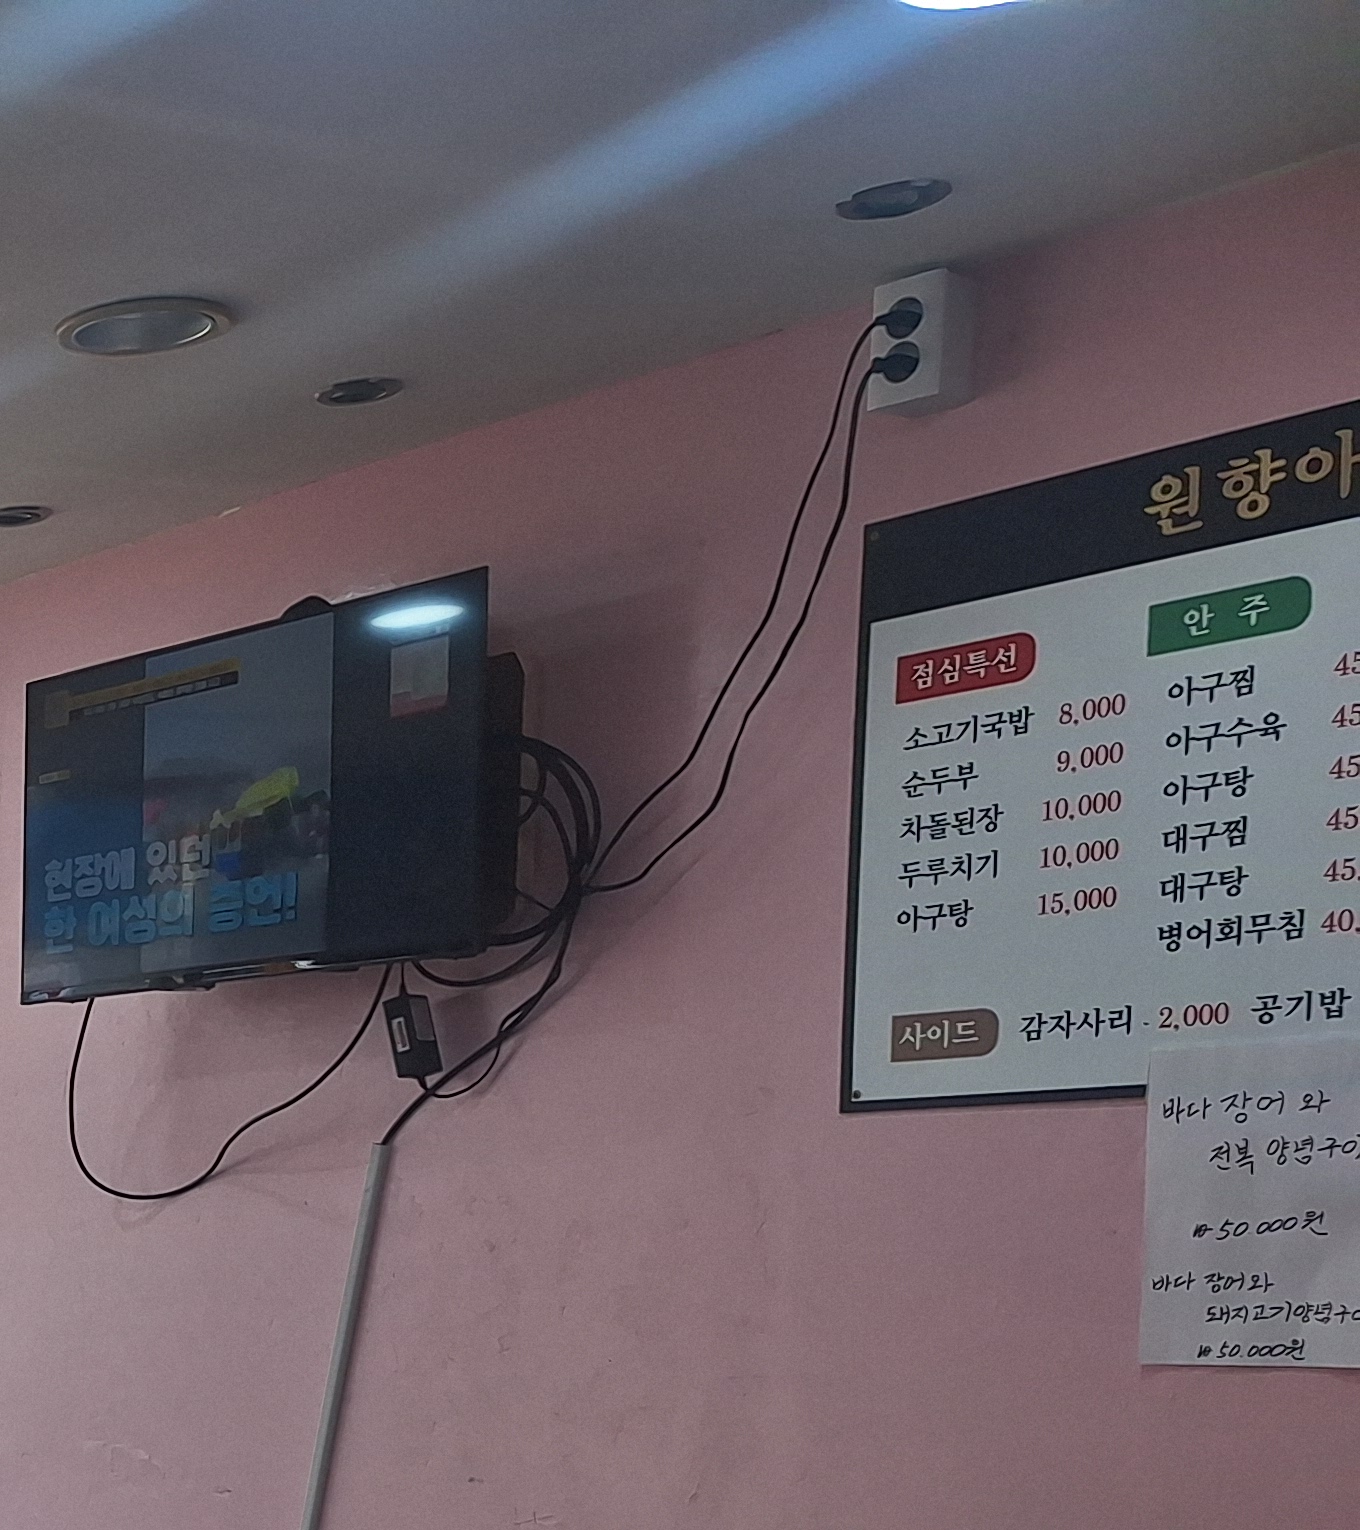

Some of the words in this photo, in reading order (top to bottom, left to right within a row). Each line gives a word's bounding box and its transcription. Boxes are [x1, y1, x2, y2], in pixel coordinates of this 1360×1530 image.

[911, 643, 1018, 690] 점심특선
[1168, 665, 1256, 706] 아구찜
[903, 707, 1035, 751] 소고기국밥
[1166, 711, 1287, 755] 아구수육
[901, 761, 979, 798] 순두부
[1163, 766, 1254, 806] 아구탕
[899, 804, 1004, 844] 차돌된장
[1162, 816, 1248, 856] 대구찜
[44, 847, 135, 903] 현장에
[898, 849, 1000, 889] 두루치기
[1160, 865, 1250, 904] 대구탕
[43, 907, 76, 954] 한
[87, 888, 196, 946] 여성의
[897, 900, 974, 933] 아구탕
[1157, 908, 1306, 953] 병어회무침
[899, 1019, 980, 1051] 사이드
[1018, 1006, 1133, 1042] 감자사리
[1249, 988, 1353, 1025] 공기밥
[1163, 1096, 1212, 1124] 바다
[1209, 1138, 1254, 1175] 전복
[1151, 1271, 1196, 1292] 바다
